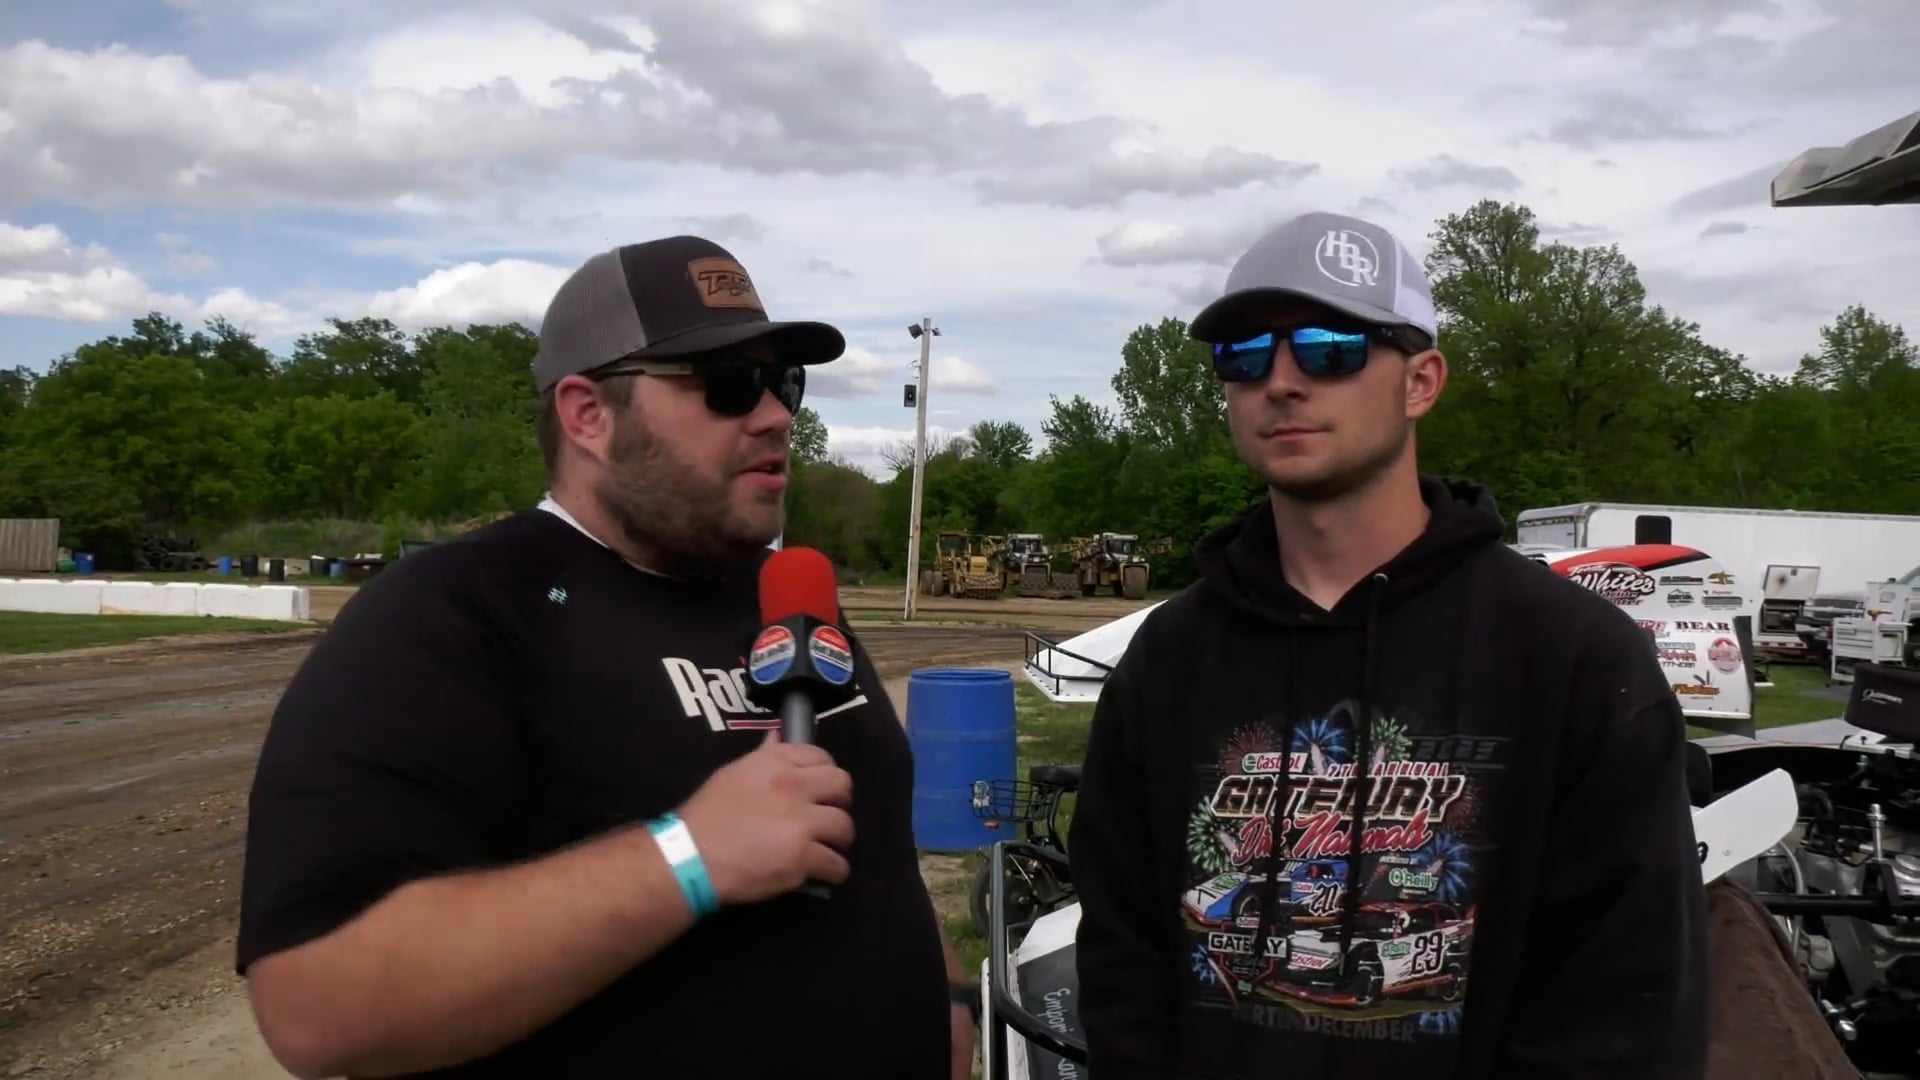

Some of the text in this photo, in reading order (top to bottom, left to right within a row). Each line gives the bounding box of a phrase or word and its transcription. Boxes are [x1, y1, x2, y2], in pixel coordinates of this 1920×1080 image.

[1675, 621, 1730, 631] BEAR
[1256, 755, 1301, 771] Castol
[1292, 809, 1433, 859] Naonals
[1389, 867, 1438, 891] O'Reilly
[1211, 934, 1283, 955] GATEY
[1036, 987, 1075, 1034] Empori
[1304, 1013, 1417, 1043] DECEMBER
